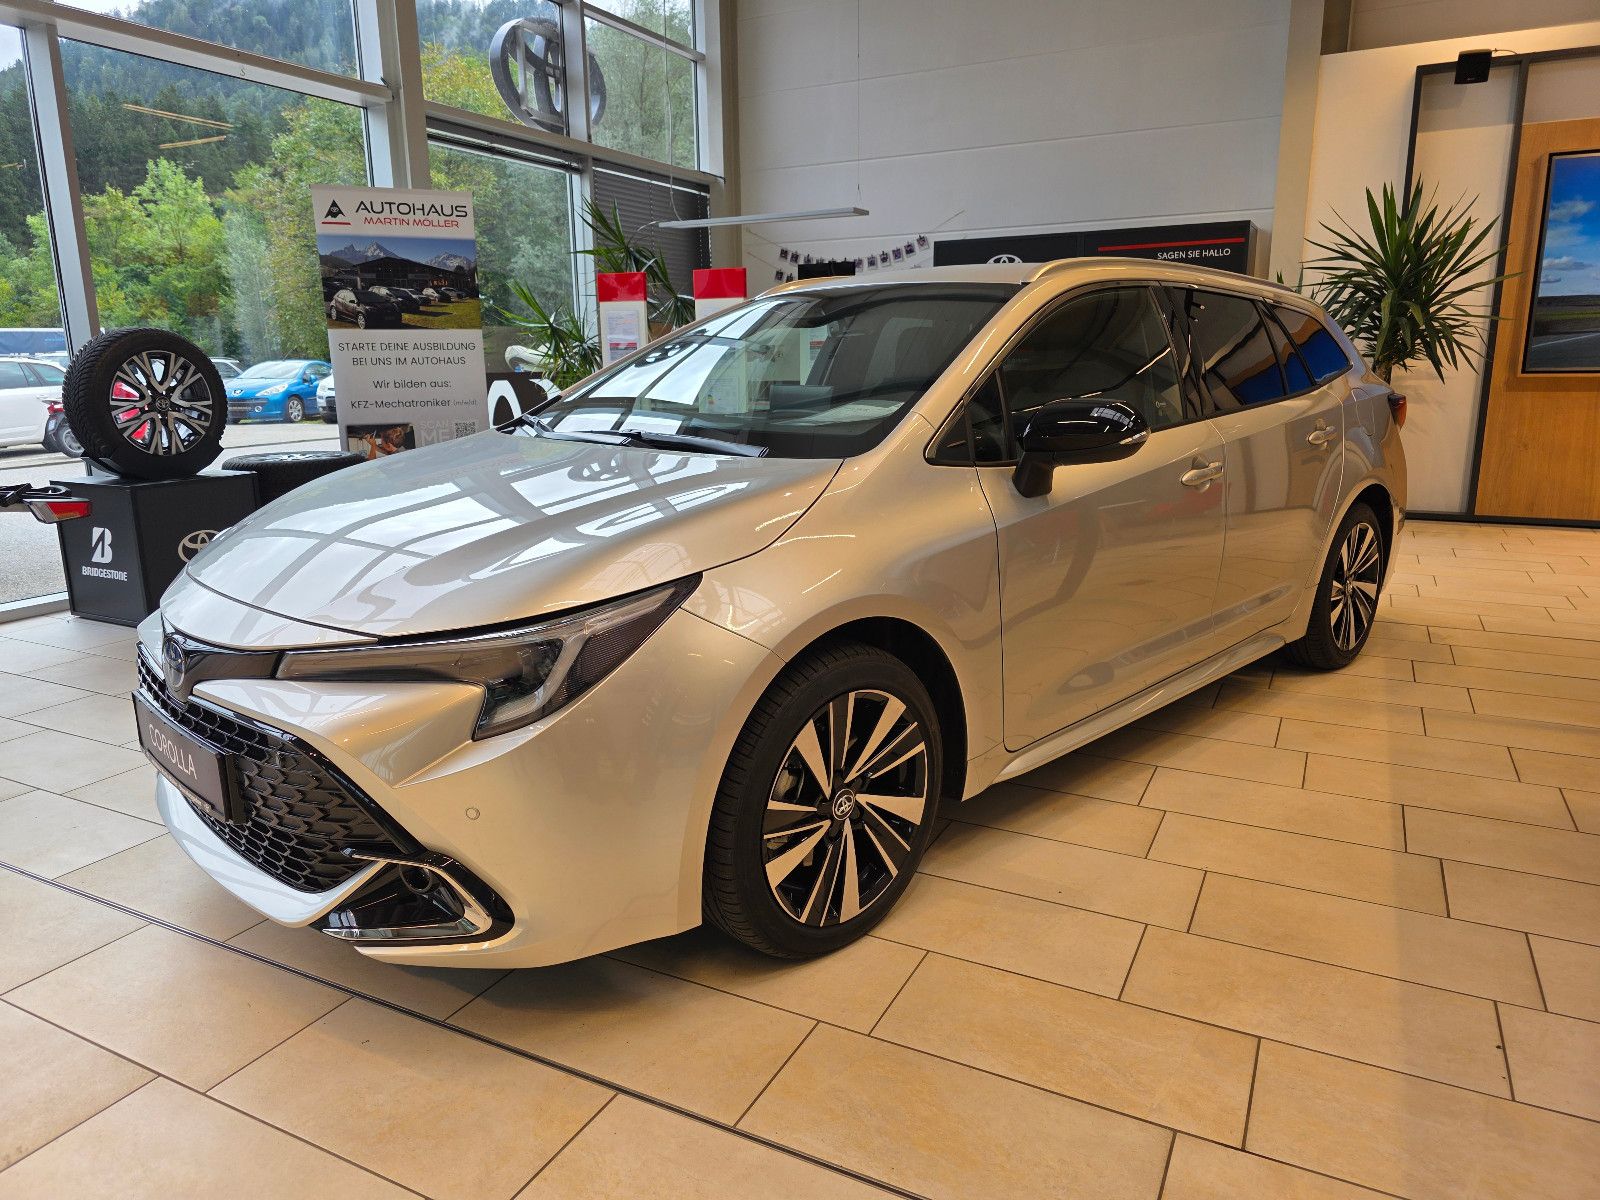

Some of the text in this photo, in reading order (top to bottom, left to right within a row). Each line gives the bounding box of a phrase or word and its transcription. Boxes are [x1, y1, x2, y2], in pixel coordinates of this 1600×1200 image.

[355, 201, 467, 217] AUTOHAUS
[364, 217, 459, 228] MARTIN MÖLLER
[1158, 248, 1231, 260] SAGEN SIE HALLO
[338, 342, 476, 352] STARTE DEINE AUSBILDUNG
[352, 356, 466, 366] BEI UNS IM AUTOHAUS
[372, 379, 452, 389] Wir bilden aus:
[350, 398, 450, 409] KFZ-Mechatroniker
[81, 565, 128, 582] BRIDGESTONE
[148, 723, 198, 780] COROLLA
